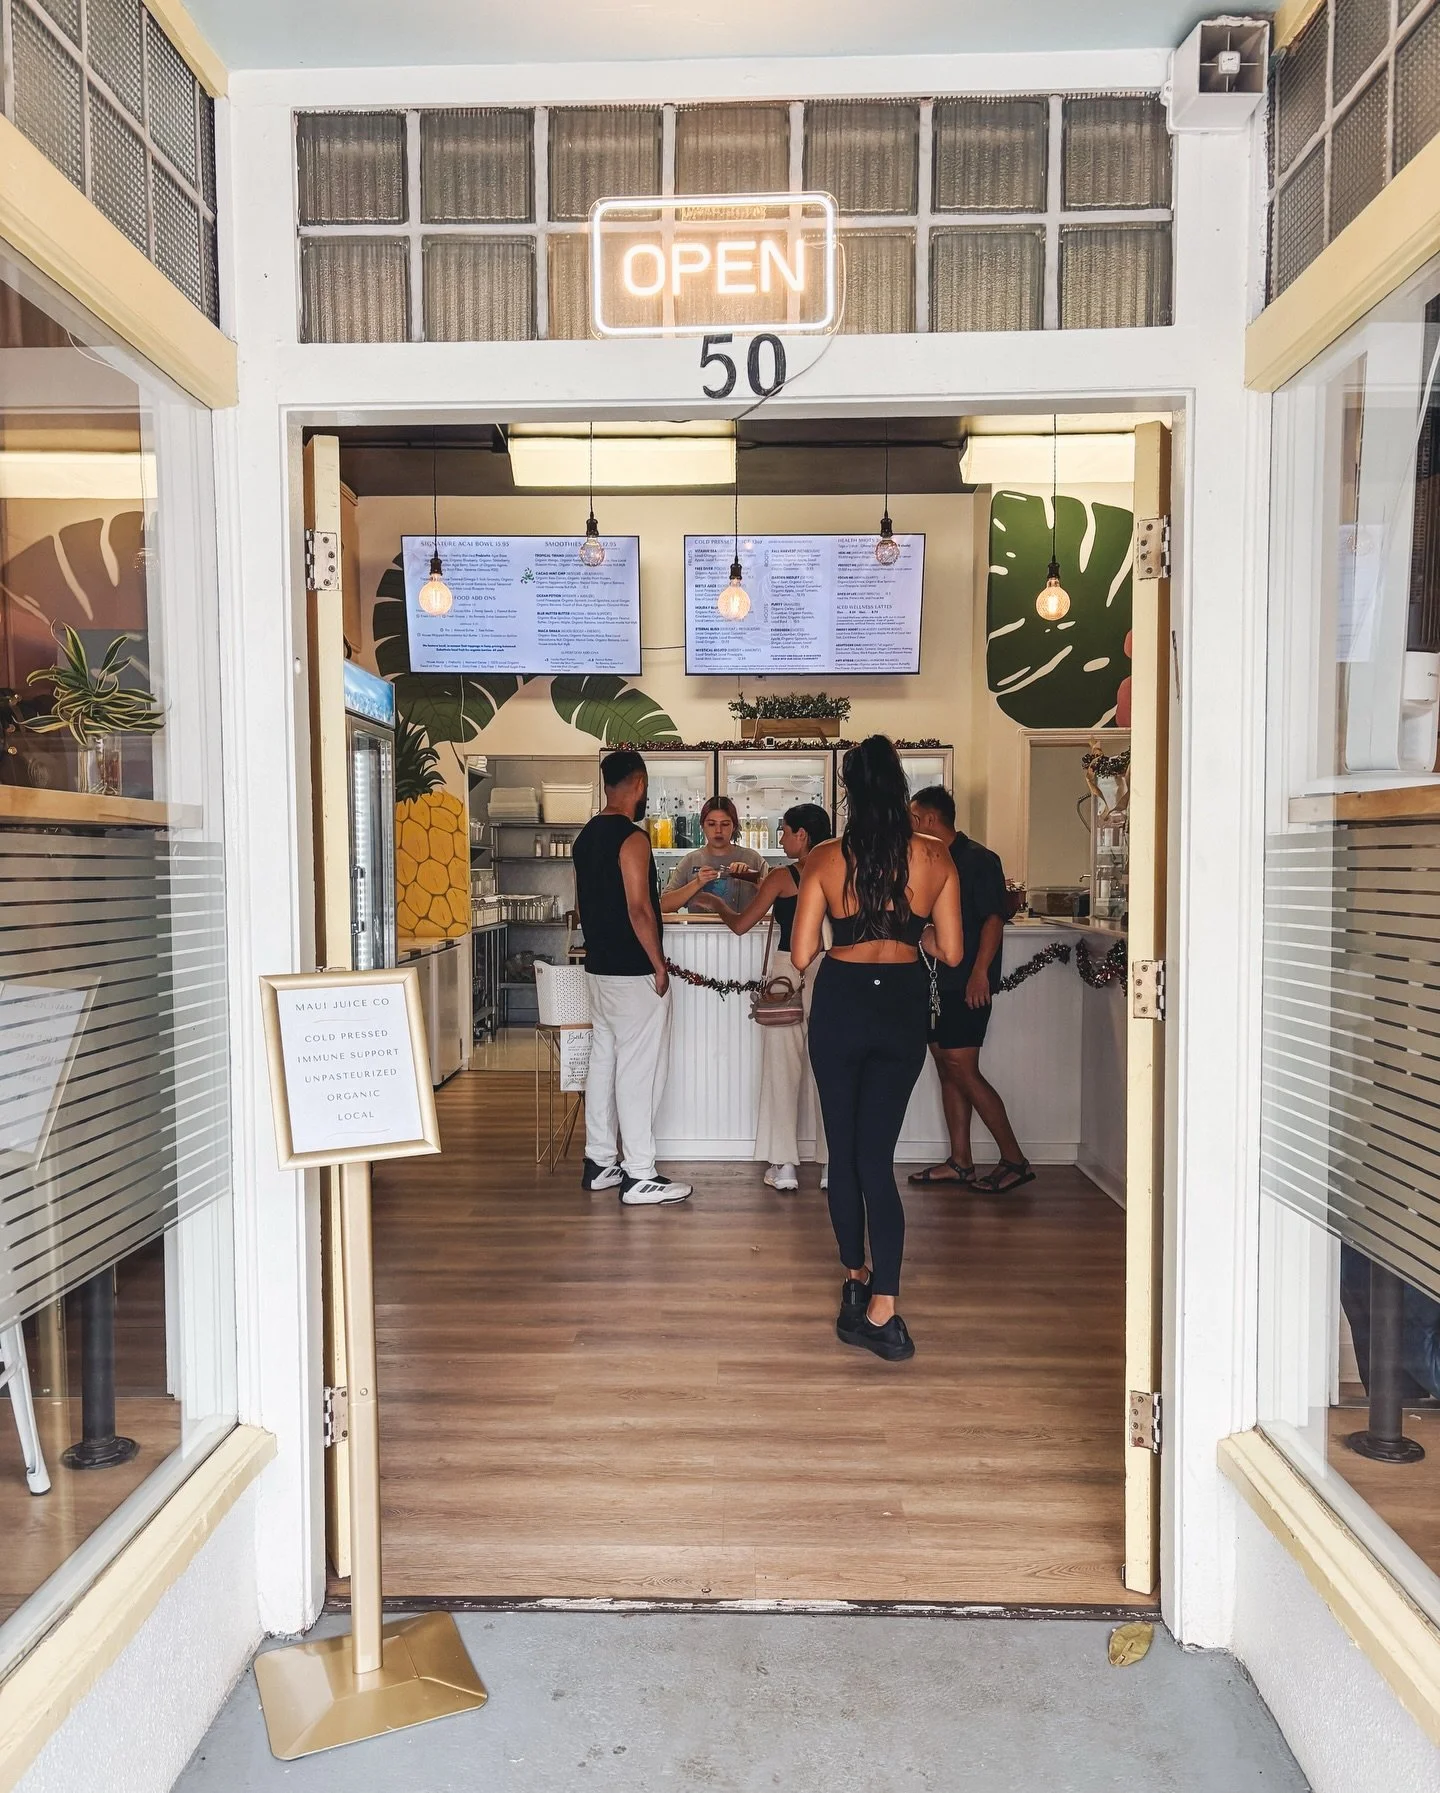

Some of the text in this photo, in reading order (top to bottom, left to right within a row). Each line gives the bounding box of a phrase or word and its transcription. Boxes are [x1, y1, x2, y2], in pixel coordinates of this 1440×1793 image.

[622, 237, 806, 298] OPEN
[700, 332, 787, 400] 50
[295, 998, 390, 1012] MAUI JUICE CO
[304, 1030, 388, 1042] COLD PRESSED
[298, 1048, 398, 1063] IMMUNE SUPPORT
[304, 1068, 397, 1083] UNPASTEURIZED
[327, 1090, 380, 1102] ORGANIC
[338, 1112, 374, 1121] LOCAL
